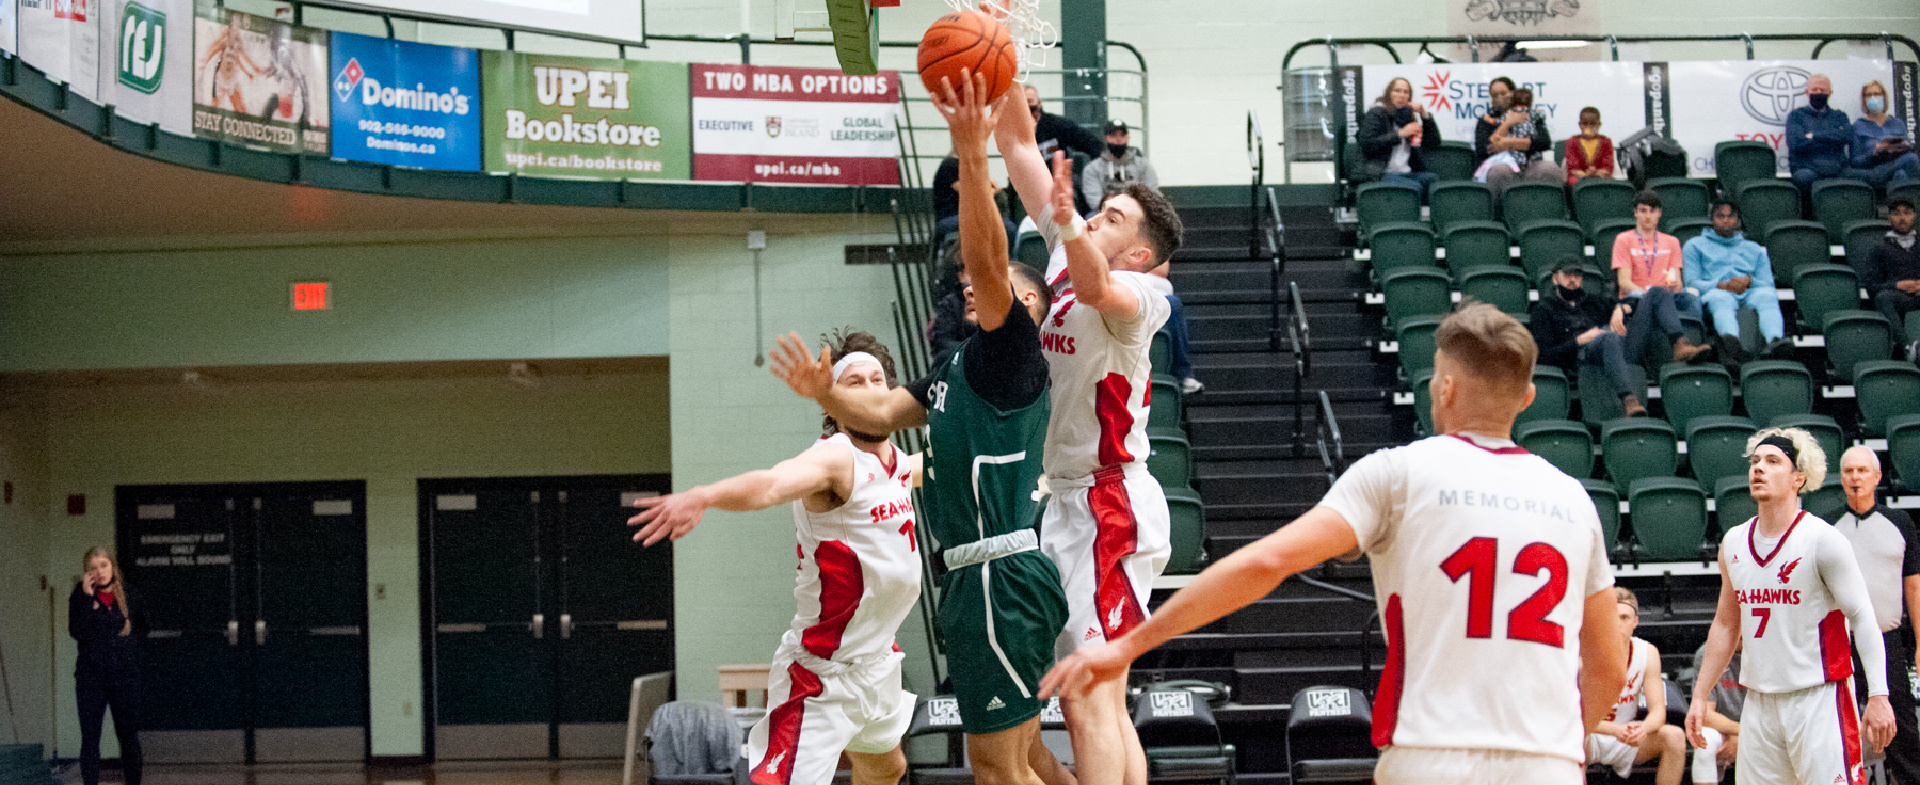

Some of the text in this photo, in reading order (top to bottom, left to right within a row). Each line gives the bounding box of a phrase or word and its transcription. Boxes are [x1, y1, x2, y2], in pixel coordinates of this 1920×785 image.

[362, 77, 469, 115] Domino's
[534, 66, 630, 109] UPEI
[703, 72, 887, 95] TWO MBA OPTIONS
[194, 110, 222, 131] STAY
[223, 118, 296, 145] CONNECTED
[506, 109, 661, 147] Bookstore
[699, 120, 754, 131] EXECUTIVE
[831, 129, 896, 141] LEADERSHIP
[843, 117, 883, 128] GLOBAL
[505, 152, 662, 172] upei.ca/bookstore
[754, 161, 842, 177] upei.ca/mba
[1438, 489, 1575, 524] MEMORIAL
[1439, 536, 1569, 649] 12
[1734, 588, 1801, 605] EAHAWKS
[1751, 607, 1771, 638] 7
